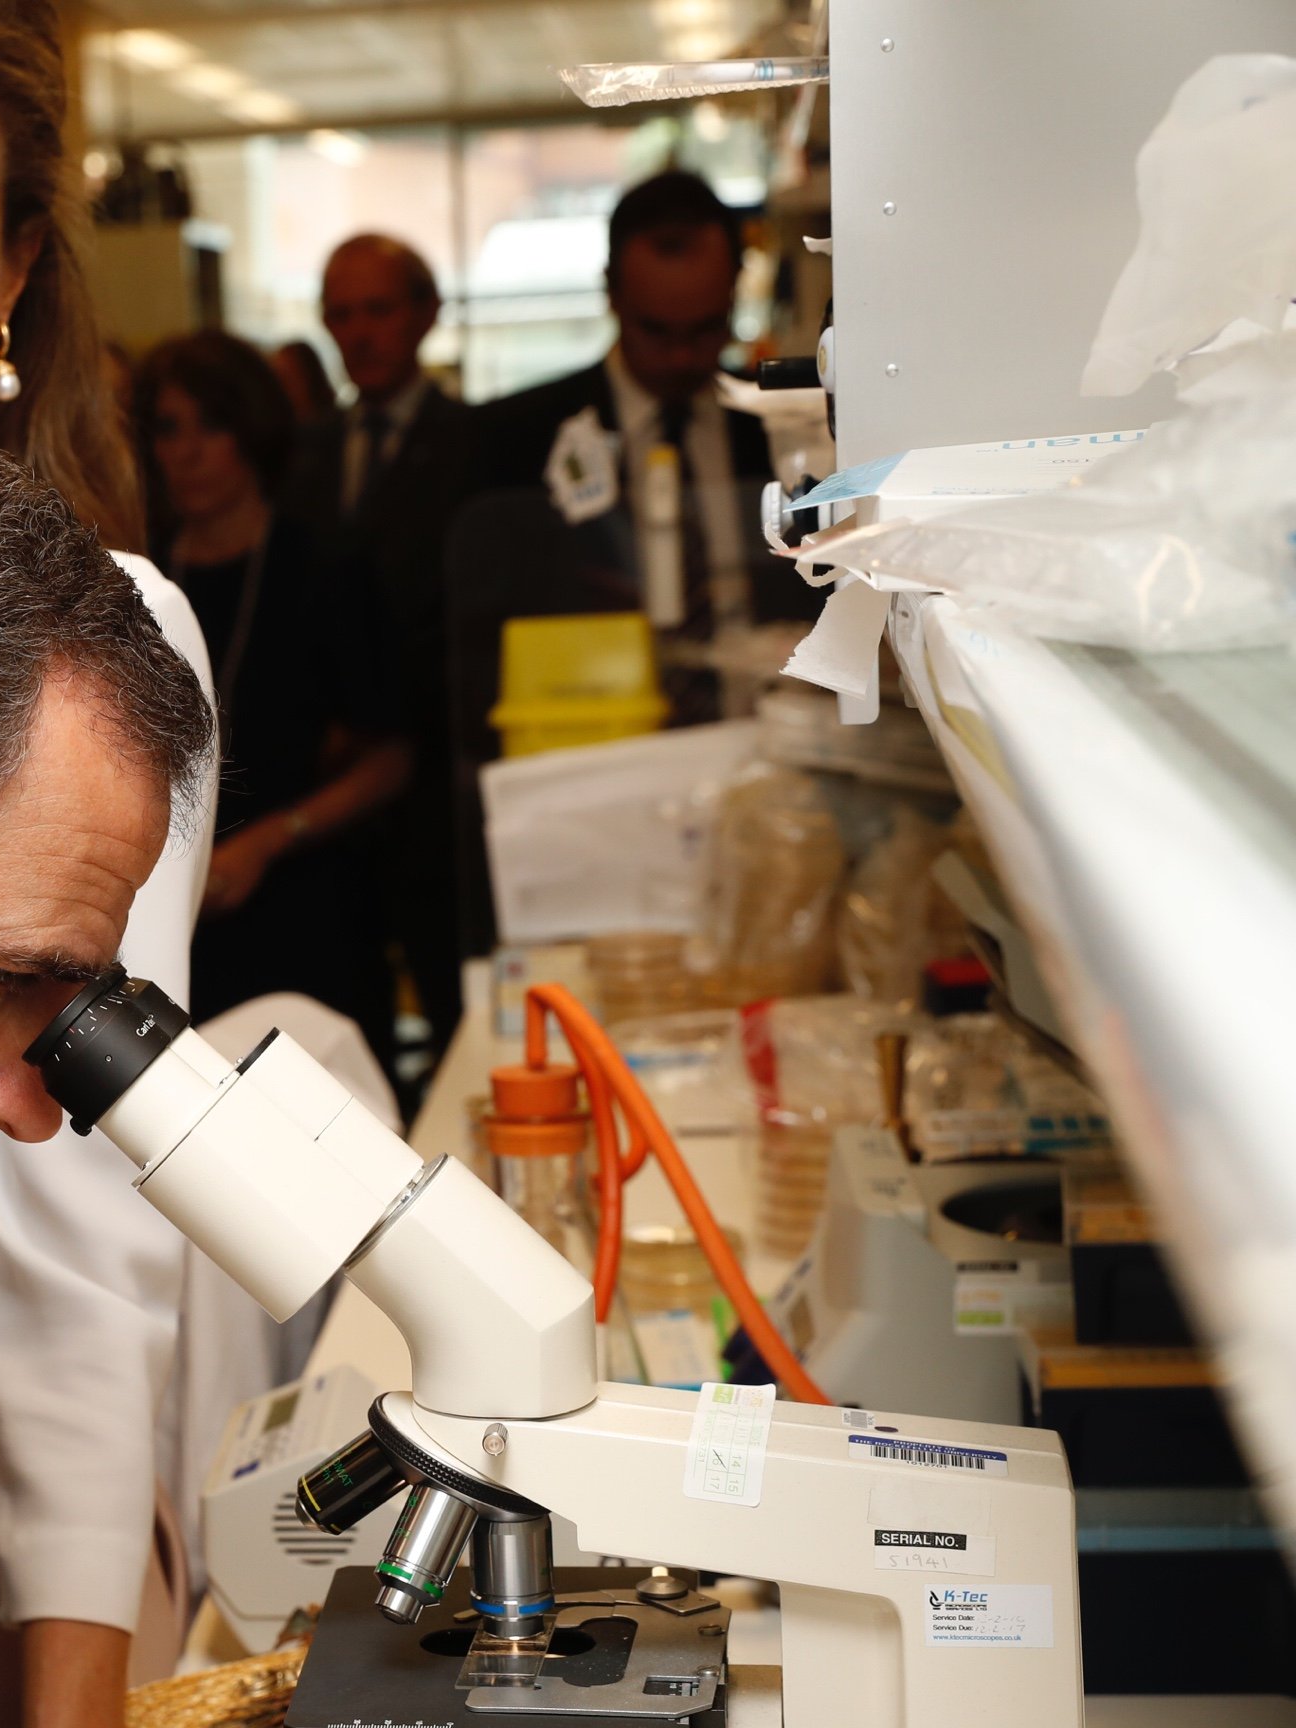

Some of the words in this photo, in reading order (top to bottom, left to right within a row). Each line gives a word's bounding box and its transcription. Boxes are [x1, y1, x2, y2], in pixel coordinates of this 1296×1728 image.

[881, 1533, 931, 1545] SERIAL
[935, 1535, 959, 1547] NO.
[943, 1589, 989, 1603] K-Tec
